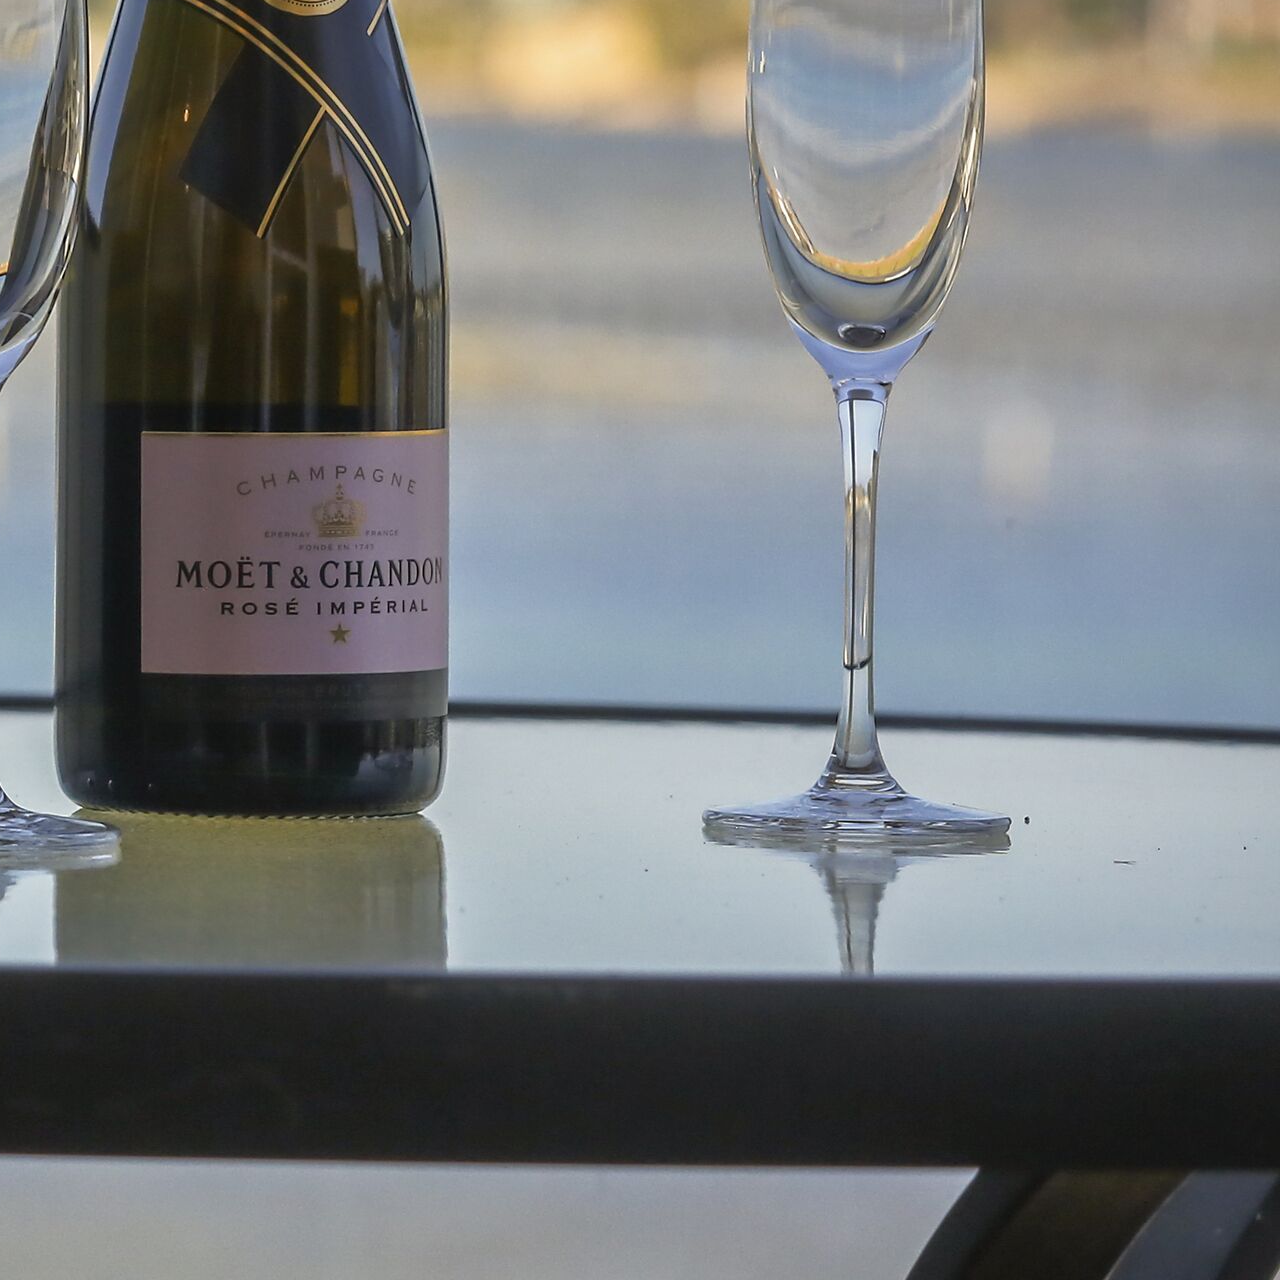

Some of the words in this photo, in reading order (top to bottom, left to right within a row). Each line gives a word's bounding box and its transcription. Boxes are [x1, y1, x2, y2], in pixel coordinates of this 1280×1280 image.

[237, 465, 417, 496] CHAMPAGNE
[176, 556, 281, 589] MOËT
[290, 566, 311, 589] &
[319, 556, 442, 589] CHANDON
[220, 598, 299, 616] ROSÉ
[316, 596, 428, 615] IMPÉRIAL
